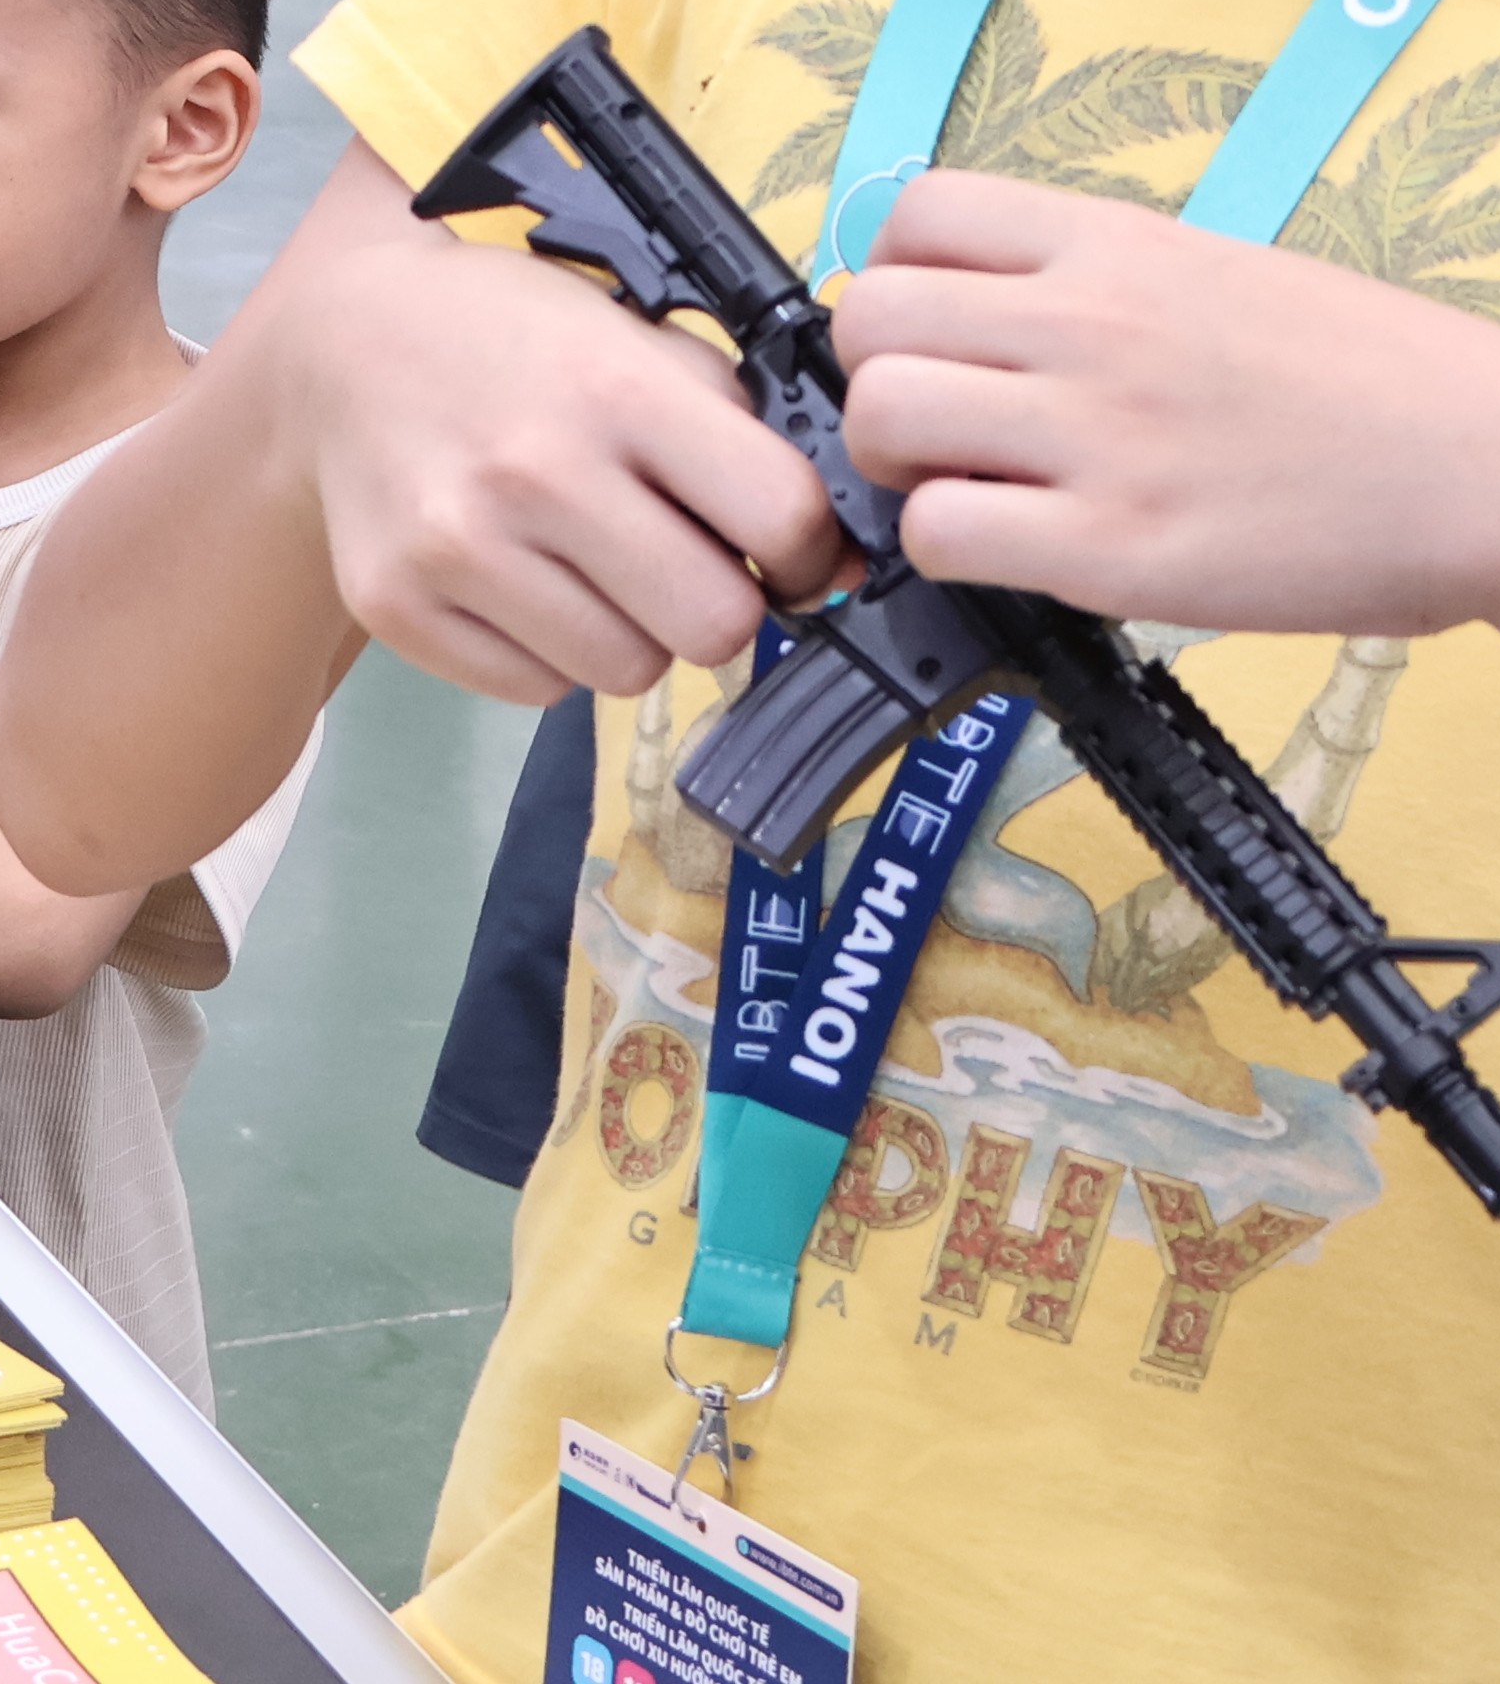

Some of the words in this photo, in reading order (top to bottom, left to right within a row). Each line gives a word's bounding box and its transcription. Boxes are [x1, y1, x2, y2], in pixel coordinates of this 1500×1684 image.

[789, 857, 918, 1087] HANOI
[669, 1601, 682, 1622] &
[579, 1650, 605, 1682] 18
[648, 1641, 668, 1668] XU
